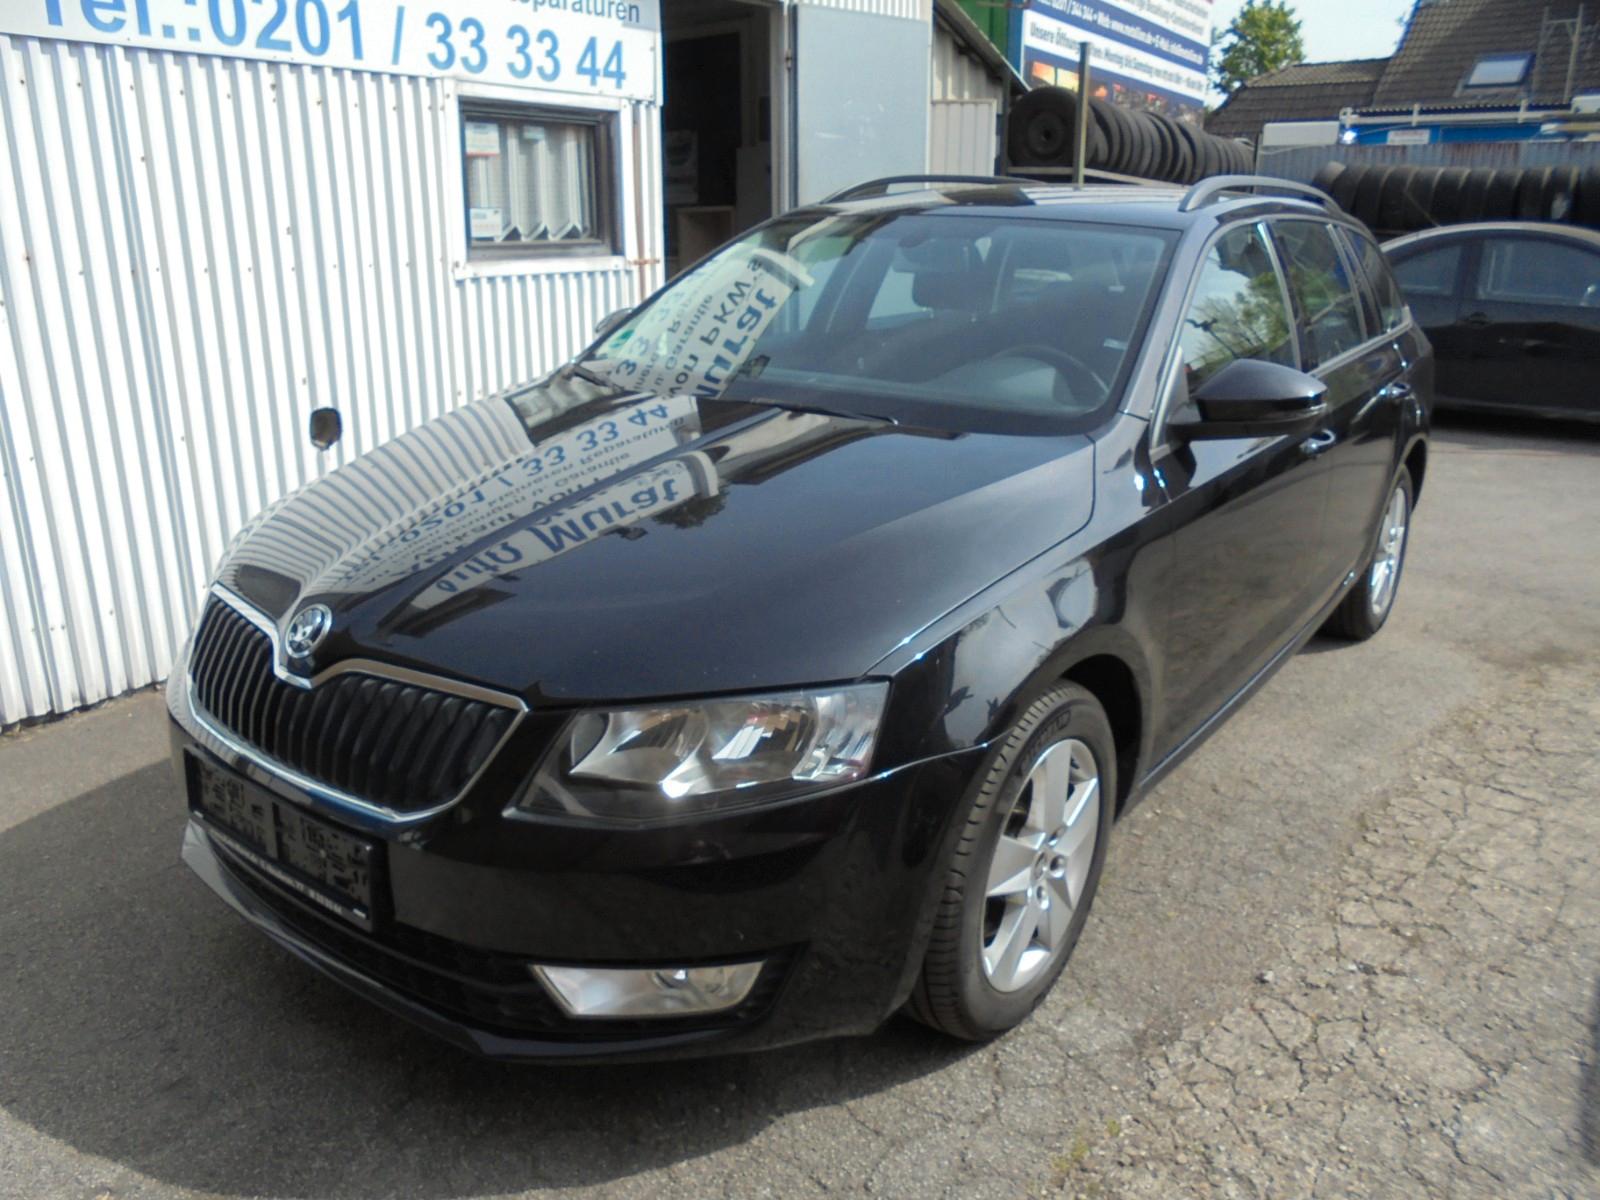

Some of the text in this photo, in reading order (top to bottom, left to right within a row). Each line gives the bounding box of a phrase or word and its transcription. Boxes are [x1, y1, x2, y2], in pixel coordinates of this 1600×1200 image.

[511, 0, 640, 23] paraturen
[392, 5, 405, 65] /
[425, 12, 488, 74] 33
[506, 24, 561, 82] 33
[576, 36, 627, 89] 44
